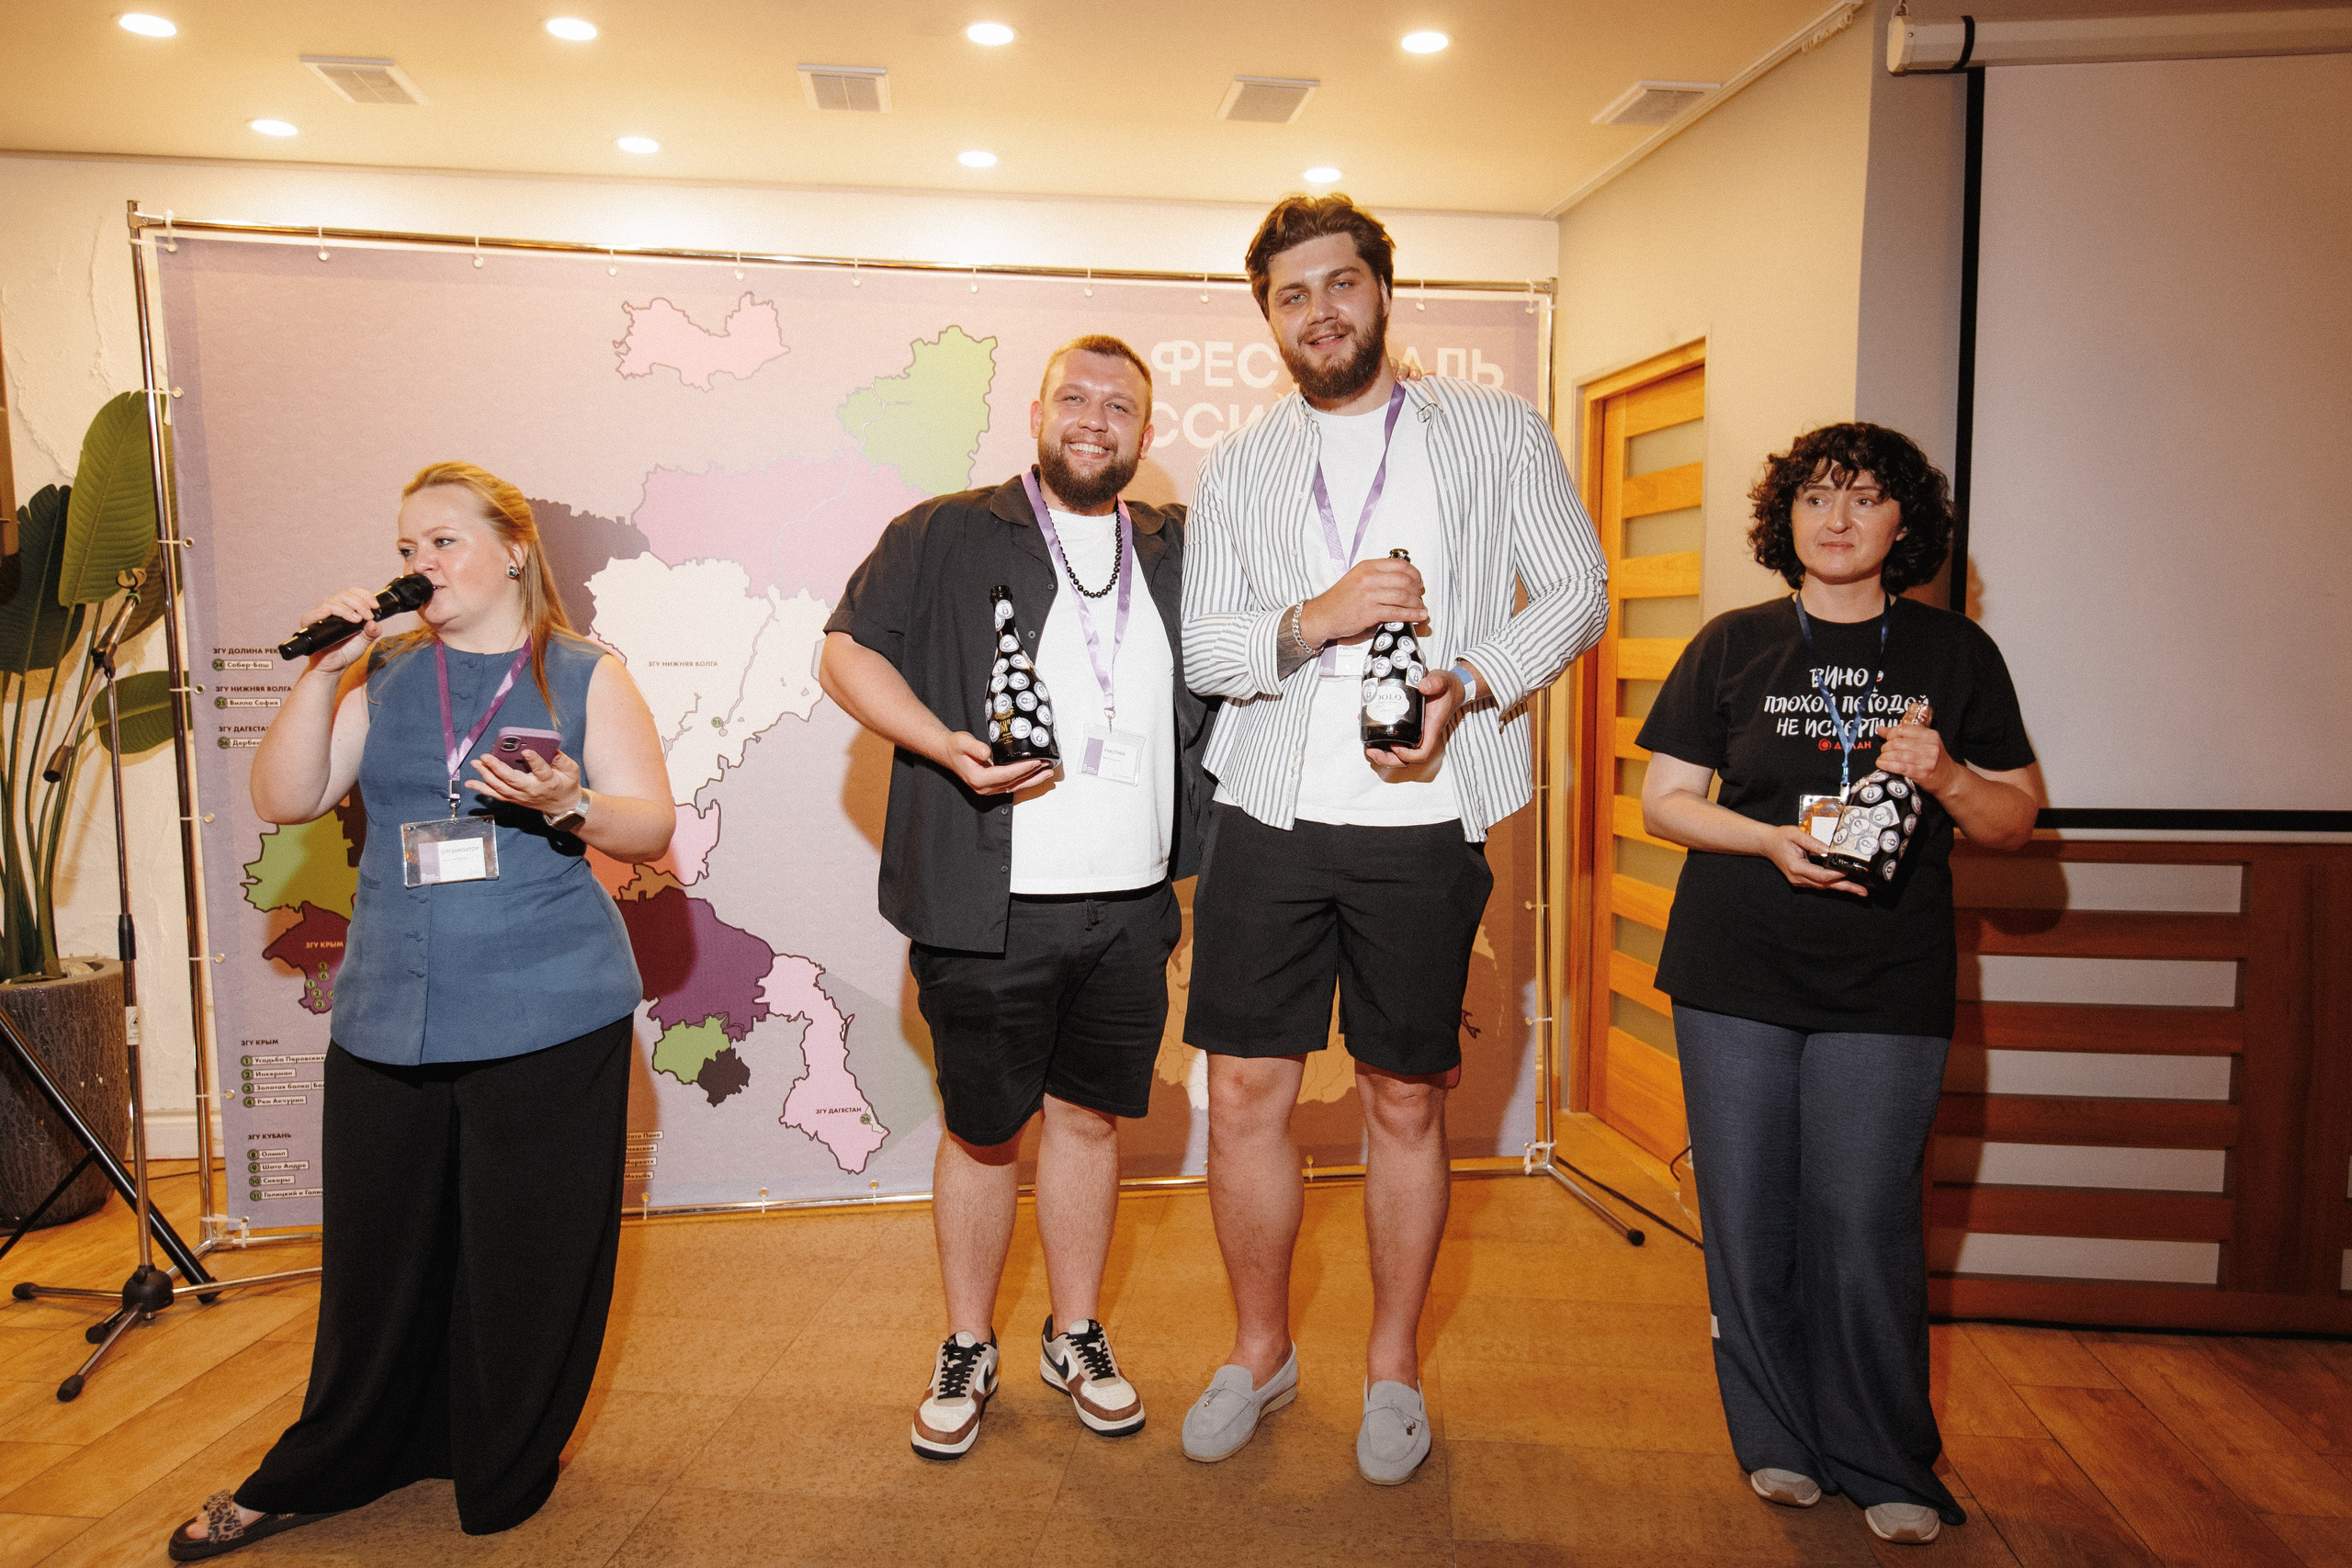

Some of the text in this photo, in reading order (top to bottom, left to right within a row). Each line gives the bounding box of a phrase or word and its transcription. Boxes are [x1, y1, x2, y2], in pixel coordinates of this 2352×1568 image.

[1150, 340, 1505, 389] ФЕСАЛЬ
[1809, 665, 1869, 689] ВИНО
[254, 699, 278, 707] София
[1776, 717, 1799, 737] НЕ
